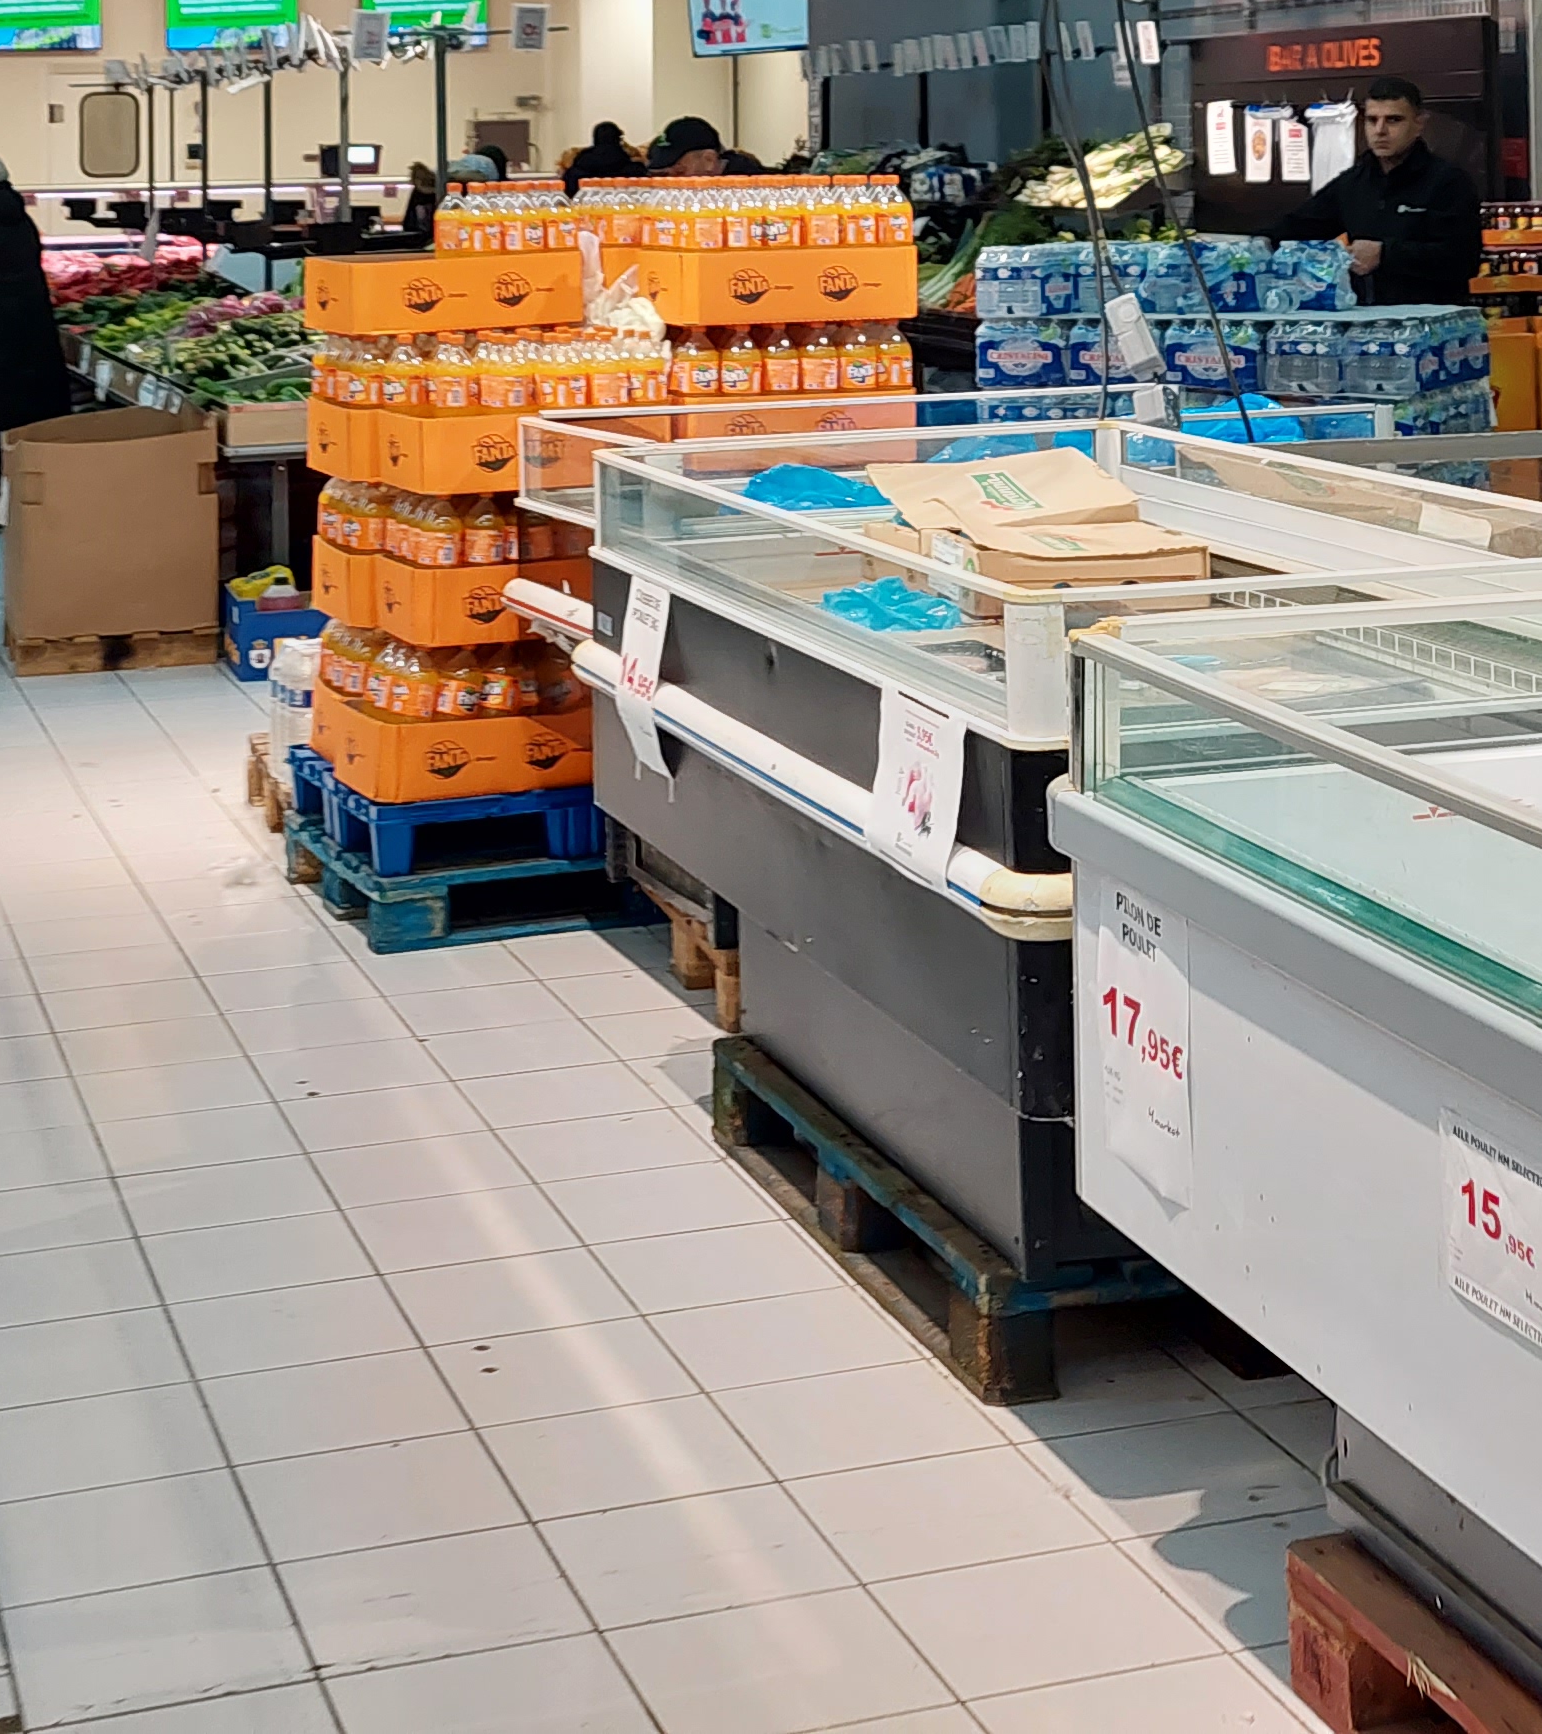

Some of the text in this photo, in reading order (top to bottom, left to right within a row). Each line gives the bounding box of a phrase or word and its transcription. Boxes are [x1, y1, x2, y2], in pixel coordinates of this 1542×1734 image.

[1321, 37, 1381, 70] OLIVES
[1116, 892, 1161, 937] PILON DE
[1122, 922, 1156, 962] POULET
[1103, 986, 1184, 1080] 17,95€
[1452, 1125, 1469, 1144] AILE
[1470, 1133, 1497, 1159] POULET
[1461, 1178, 1536, 1269] 15,95€
[1454, 1275, 1470, 1295] AILE
[1471, 1286, 1499, 1314] POULET
